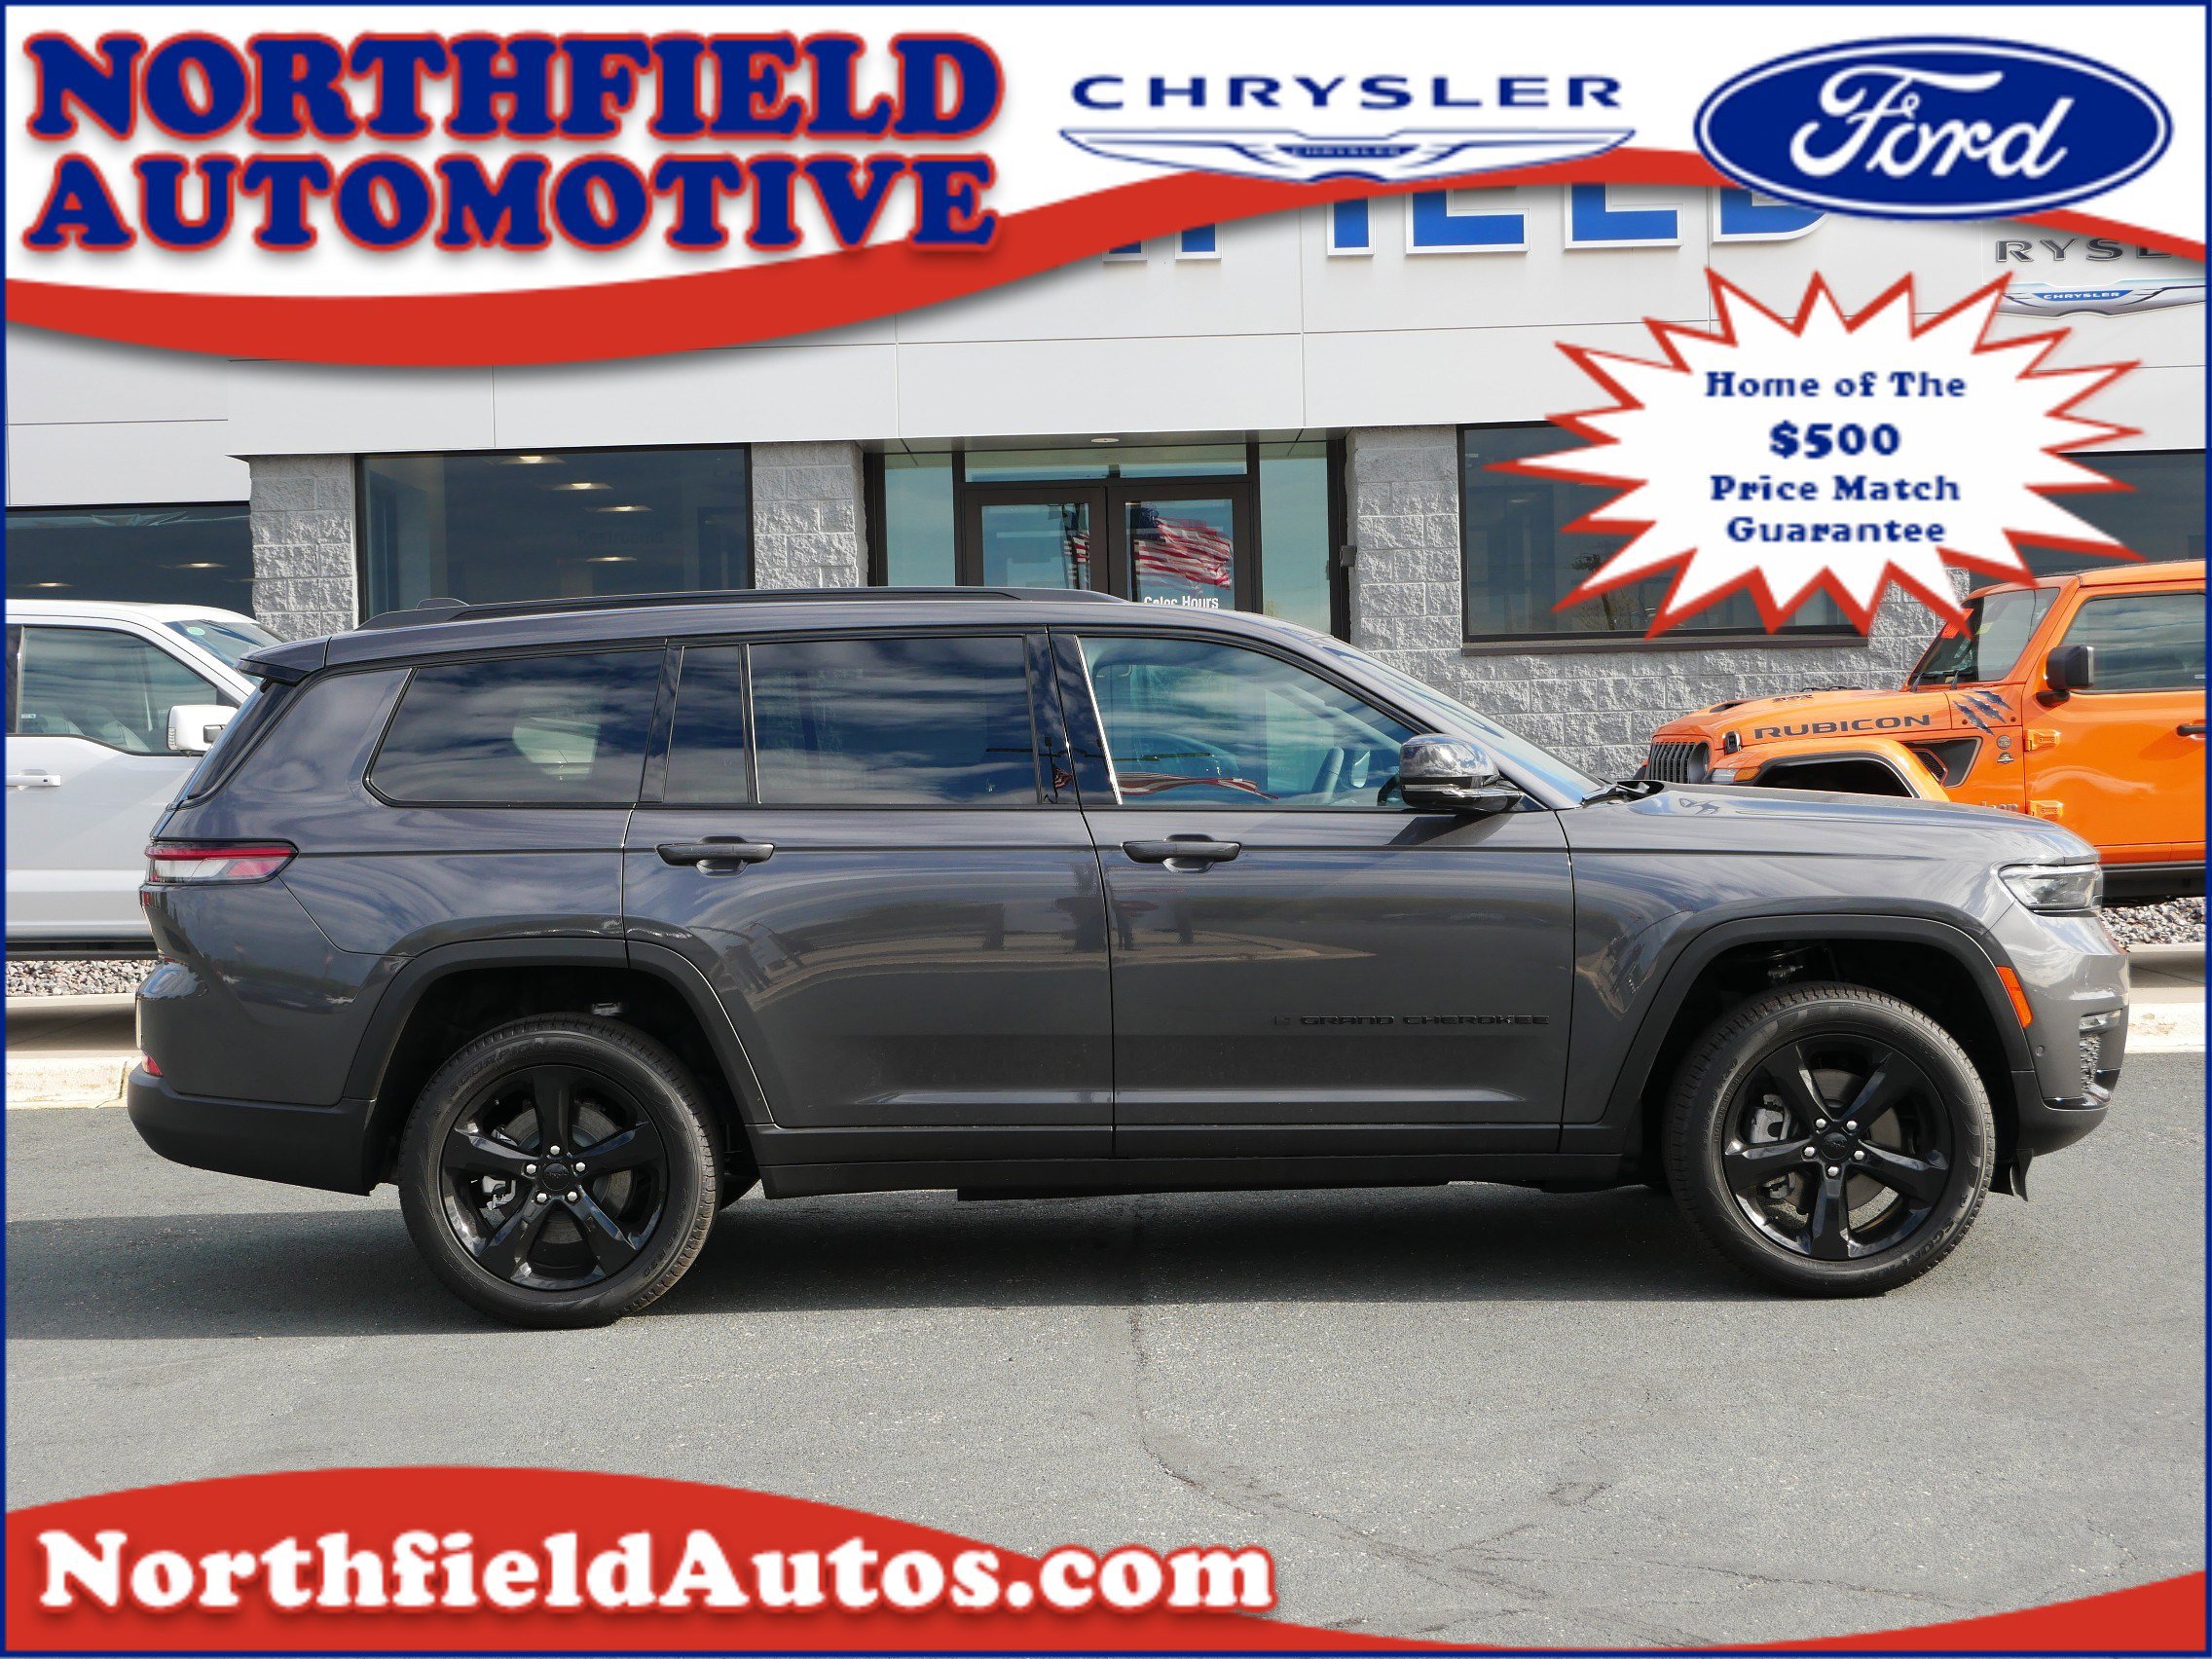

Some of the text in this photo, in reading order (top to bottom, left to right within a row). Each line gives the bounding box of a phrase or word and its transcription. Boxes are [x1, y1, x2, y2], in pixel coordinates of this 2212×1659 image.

[2043, 291, 2120, 300] CHRYSLER
[1182, 596, 1219, 609] Hours
[1754, 715, 1930, 739] RUBICON
[1300, 1014, 1550, 1025] GRAND CHEROKEE
